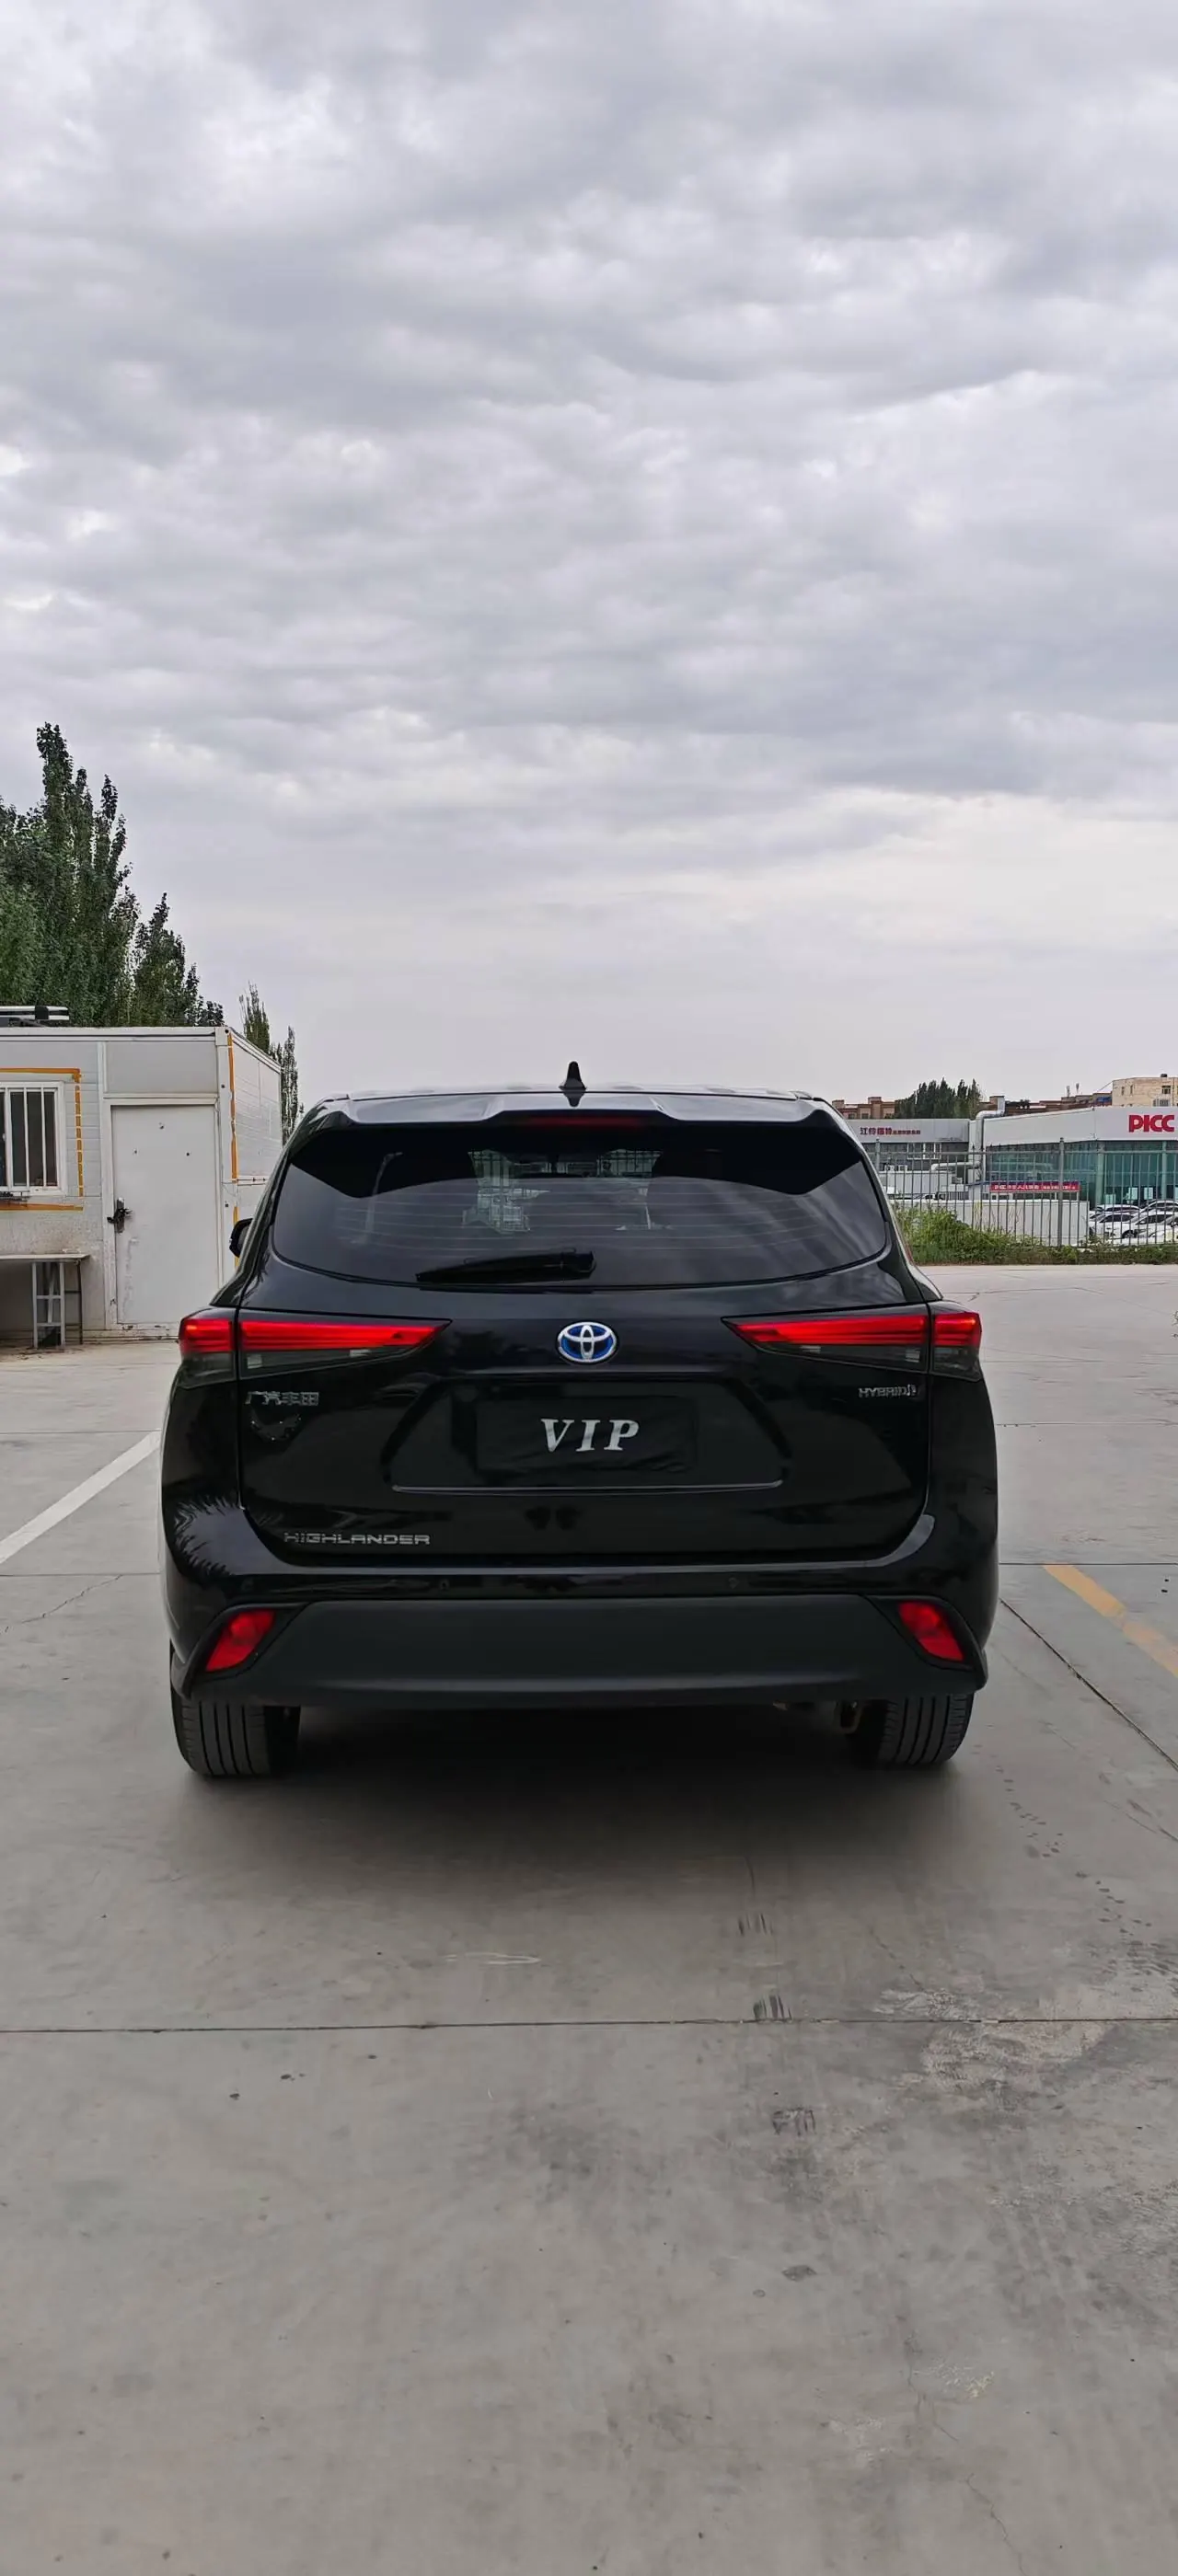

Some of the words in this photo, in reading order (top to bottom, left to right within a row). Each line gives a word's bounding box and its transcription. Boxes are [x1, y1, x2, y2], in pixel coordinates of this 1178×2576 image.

[1128, 1114, 1175, 1133] PICC
[858, 1386, 907, 1398] HYBRID
[540, 1419, 640, 1452] VIP
[283, 1532, 431, 1545] HIGHLANDER
